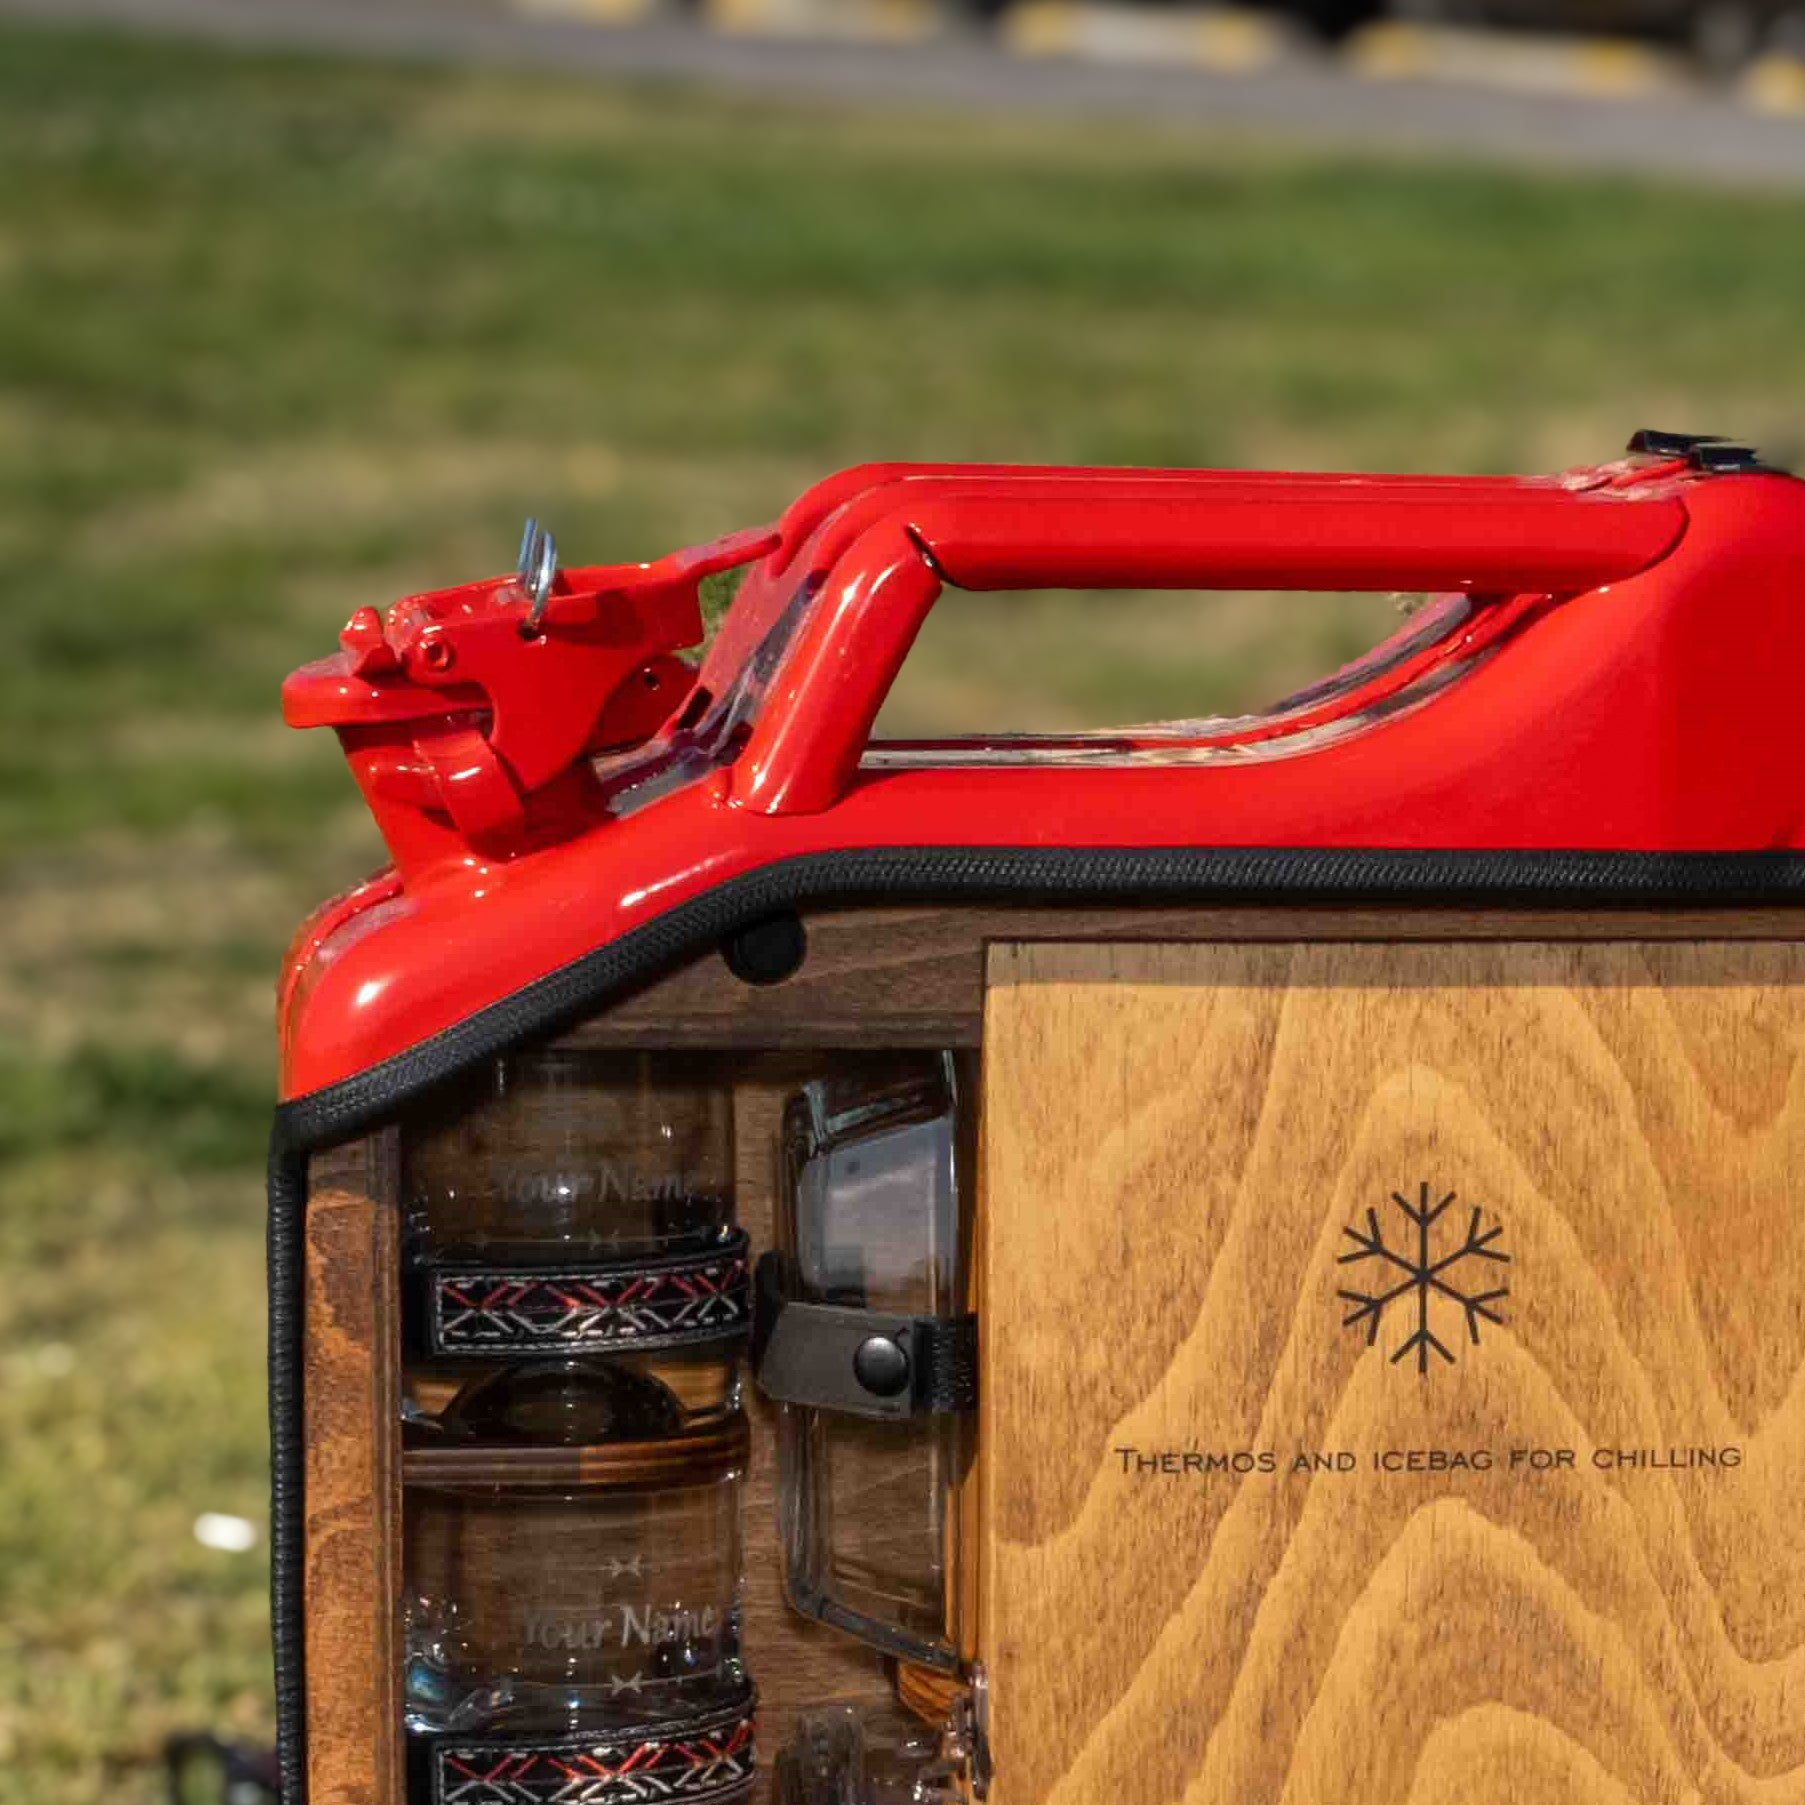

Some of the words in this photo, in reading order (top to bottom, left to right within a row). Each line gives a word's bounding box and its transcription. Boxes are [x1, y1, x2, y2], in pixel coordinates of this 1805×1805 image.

[1293, 1450, 1357, 1472] AND
[1372, 1449, 1494, 1472] ICEBAG
[1509, 1448, 1576, 1470] FOR
[1591, 1446, 1742, 1469] CHILLING
[523, 1603, 613, 1649] Your
[614, 1603, 718, 1648] Name
